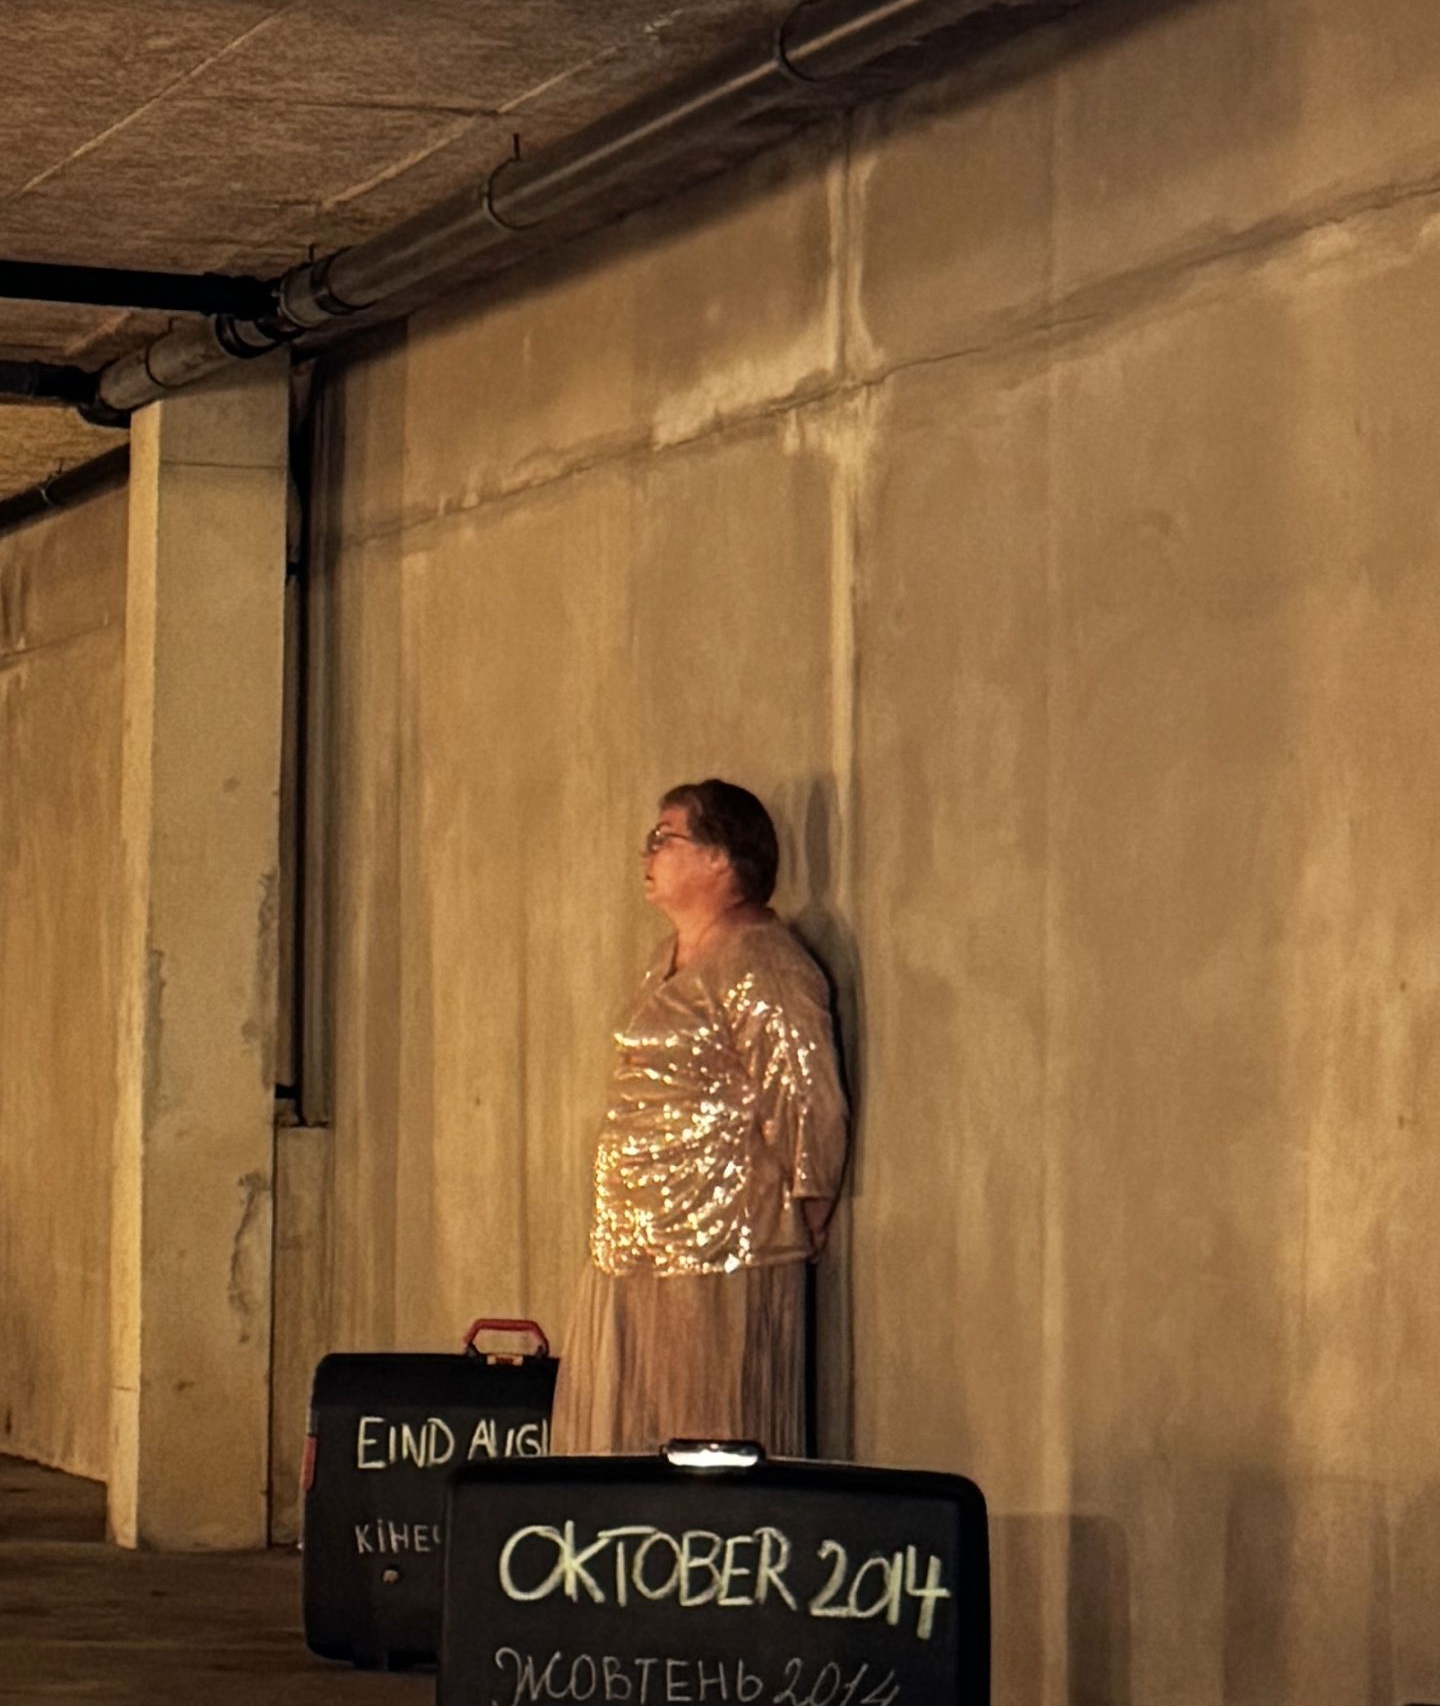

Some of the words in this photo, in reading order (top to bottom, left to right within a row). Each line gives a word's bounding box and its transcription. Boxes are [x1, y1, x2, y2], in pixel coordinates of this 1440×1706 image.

[357, 1416, 455, 1469] EIND
[499, 1519, 797, 1610] OKTOBER
[810, 1539, 952, 1640] 2014
